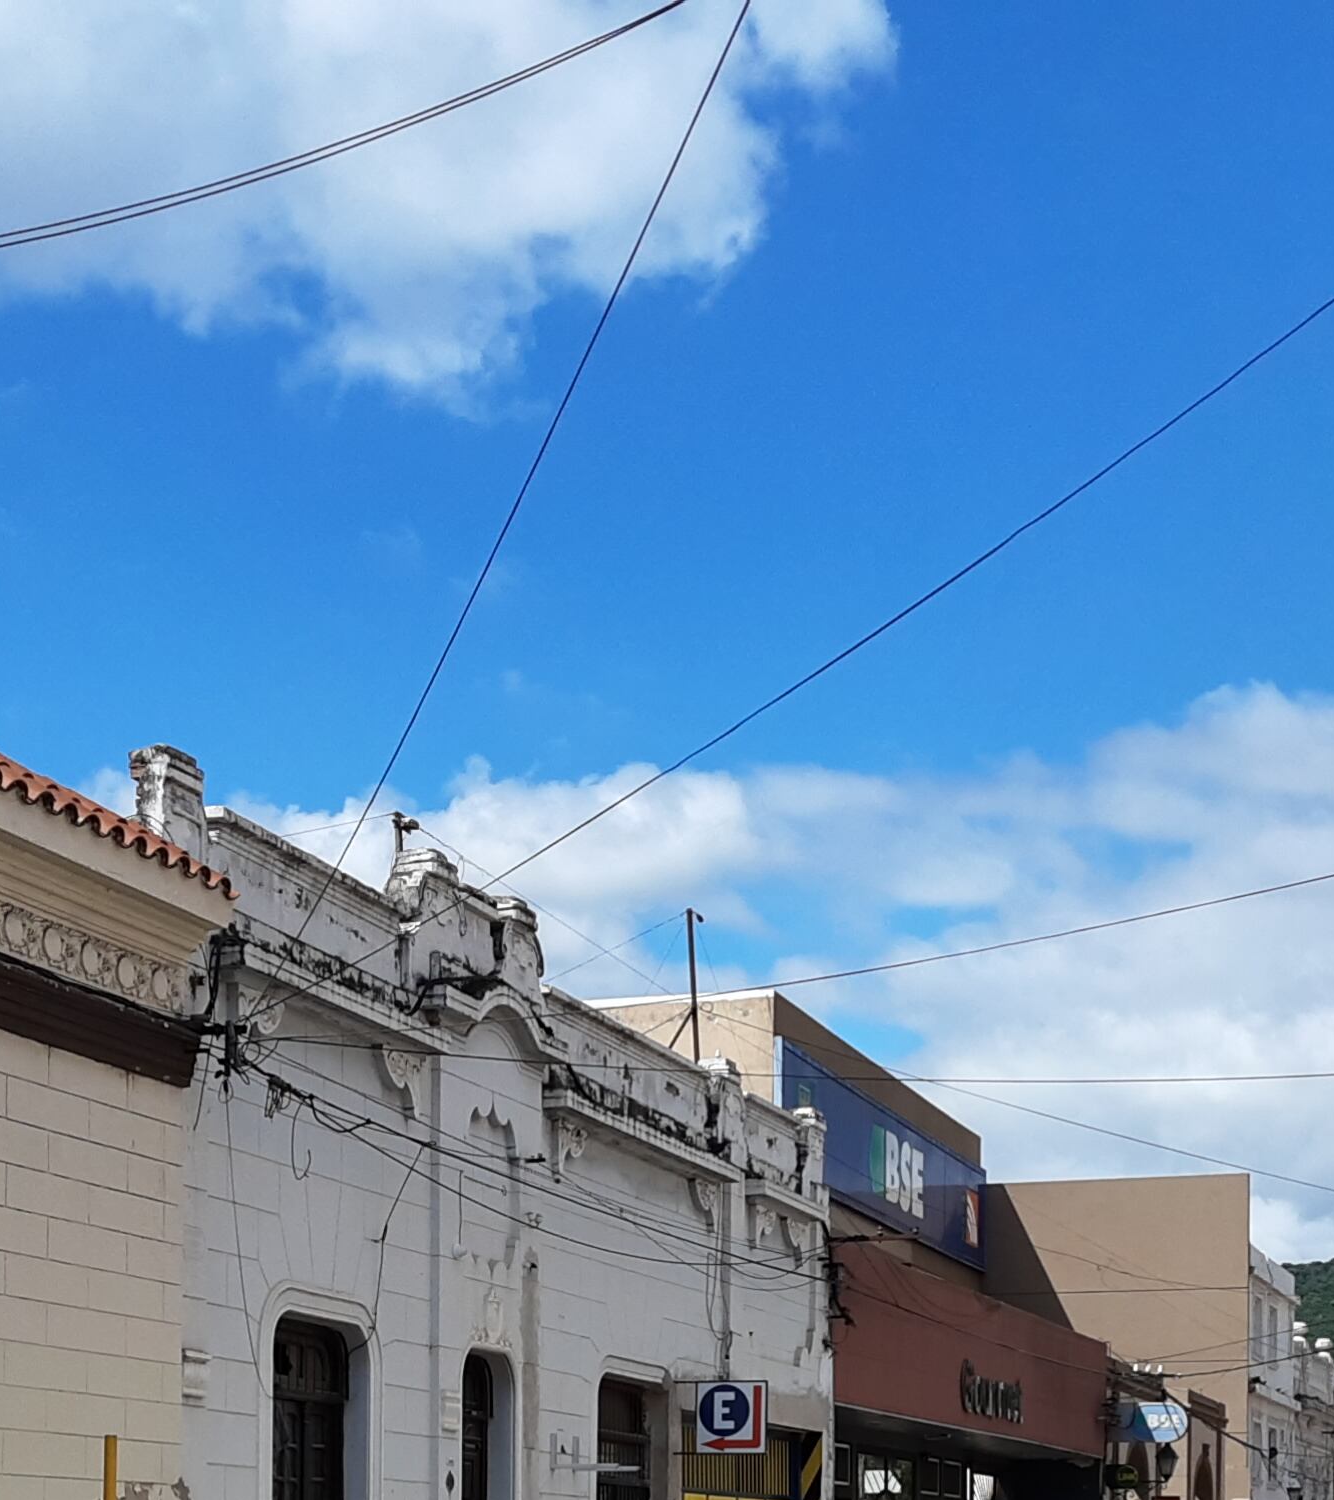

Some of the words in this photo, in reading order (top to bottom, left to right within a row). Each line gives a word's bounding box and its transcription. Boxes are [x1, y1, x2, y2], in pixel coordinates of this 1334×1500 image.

[886, 1130, 924, 1219] BSE
[714, 1391, 736, 1429] E
[1147, 1413, 1180, 1428] BSE
